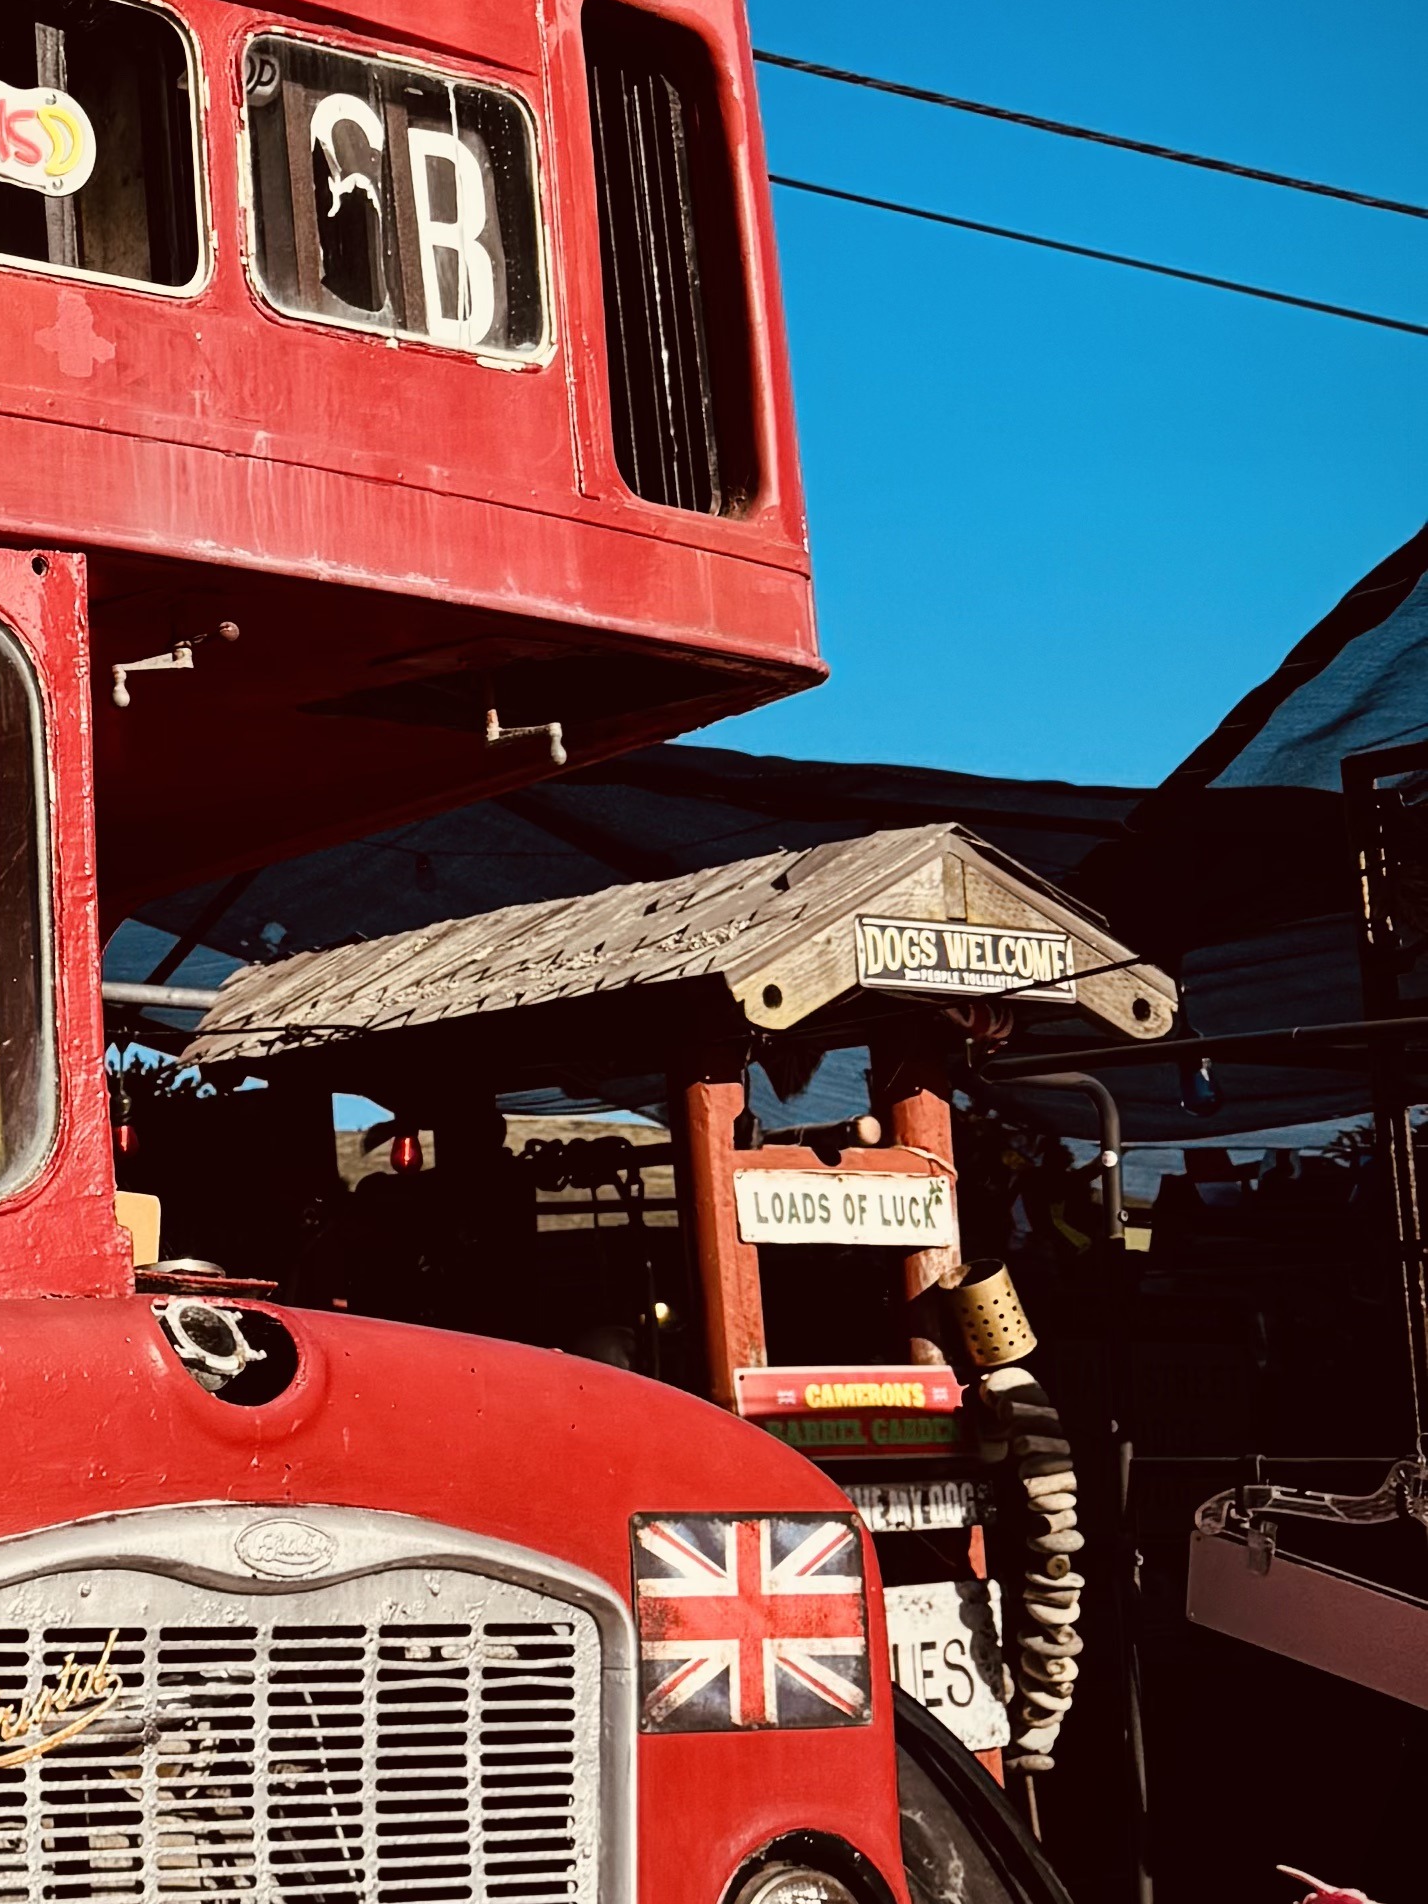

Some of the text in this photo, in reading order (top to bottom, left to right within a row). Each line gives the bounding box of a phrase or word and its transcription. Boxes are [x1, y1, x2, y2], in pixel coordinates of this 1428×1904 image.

[863, 926, 1069, 988] DOGS WELCOME
[753, 1192, 937, 1229] LOADS OF LUCK
